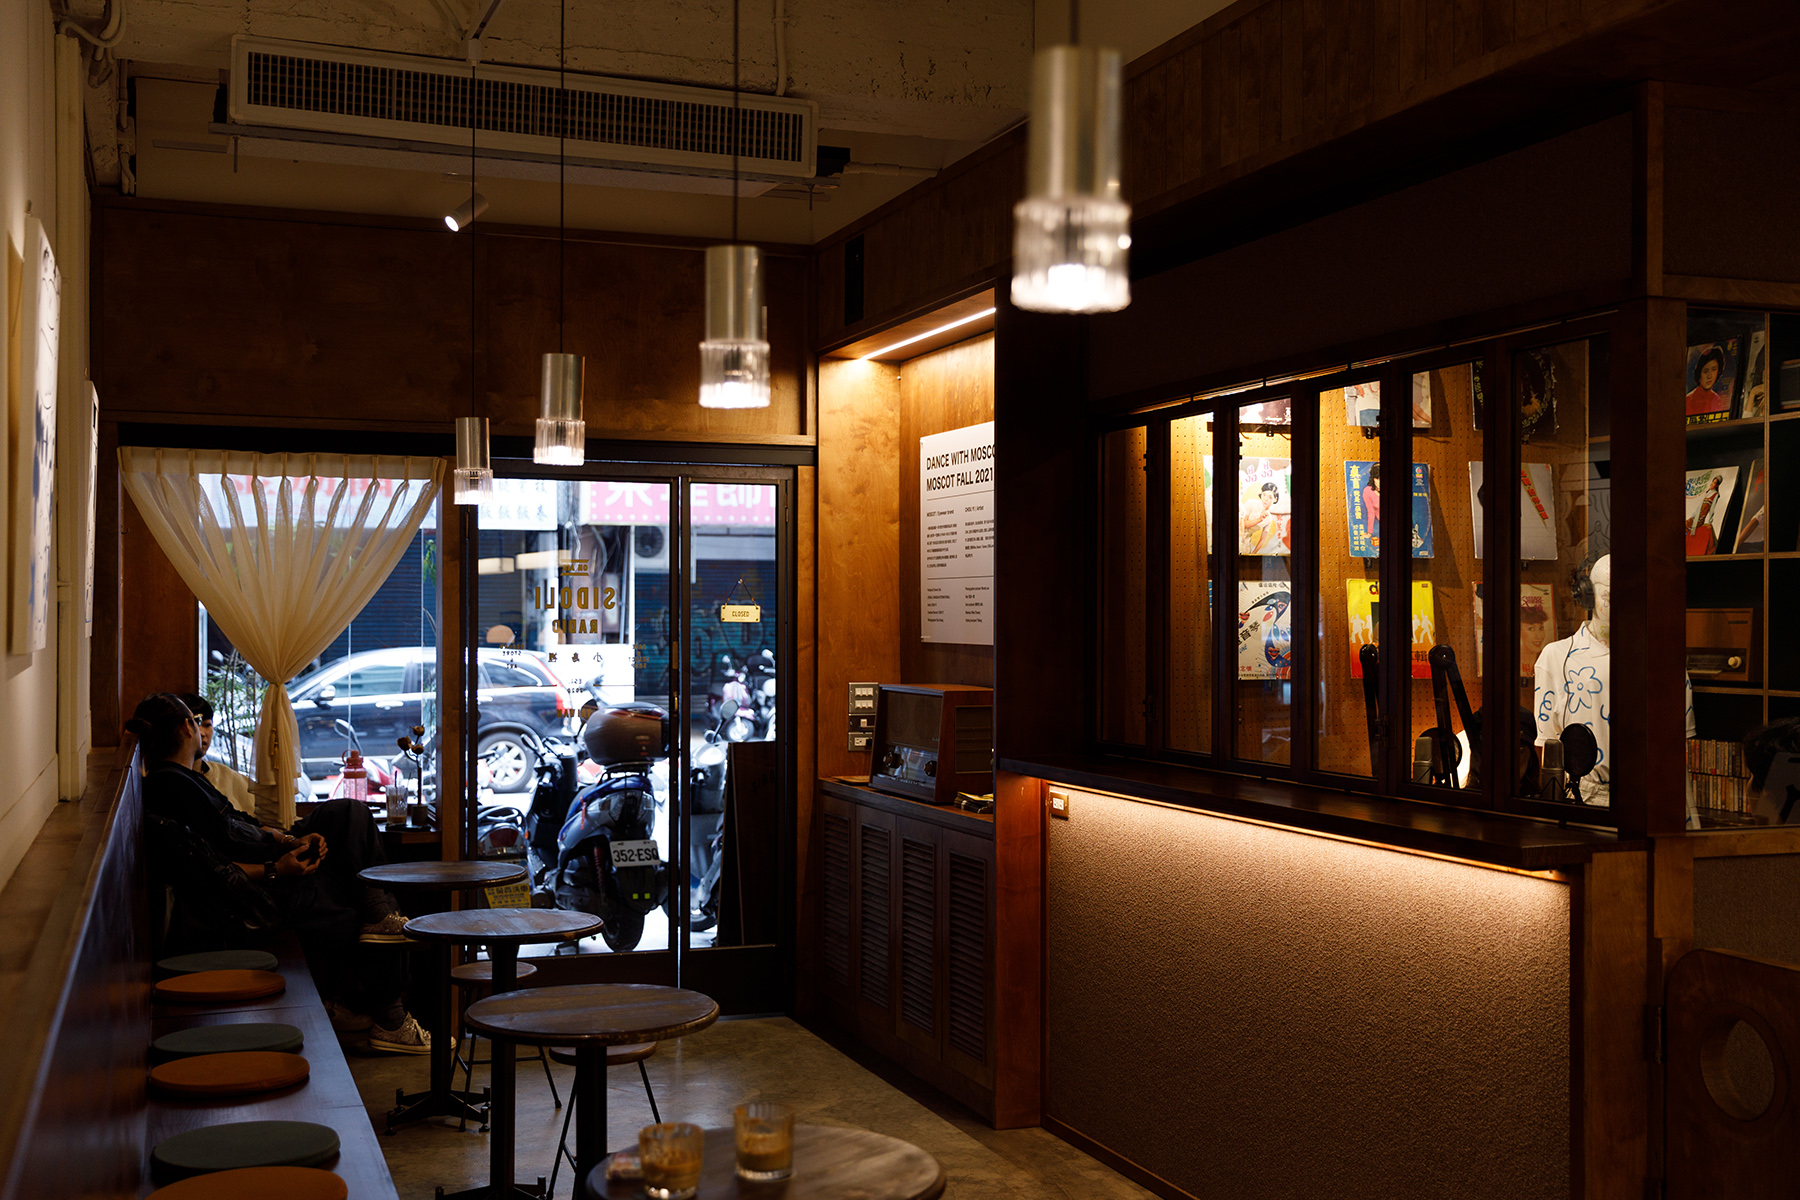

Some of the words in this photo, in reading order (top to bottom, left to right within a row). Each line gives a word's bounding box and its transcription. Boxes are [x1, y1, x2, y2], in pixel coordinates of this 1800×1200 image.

[926, 453, 949, 471] DANCE
[951, 449, 969, 466] WITH
[926, 473, 955, 492] MOSCOT
[956, 471, 974, 487] FALL
[975, 467, 993, 484] 2021
[731, 610, 750, 618] CLOSED
[612, 847, 660, 863] 352-ESQ
